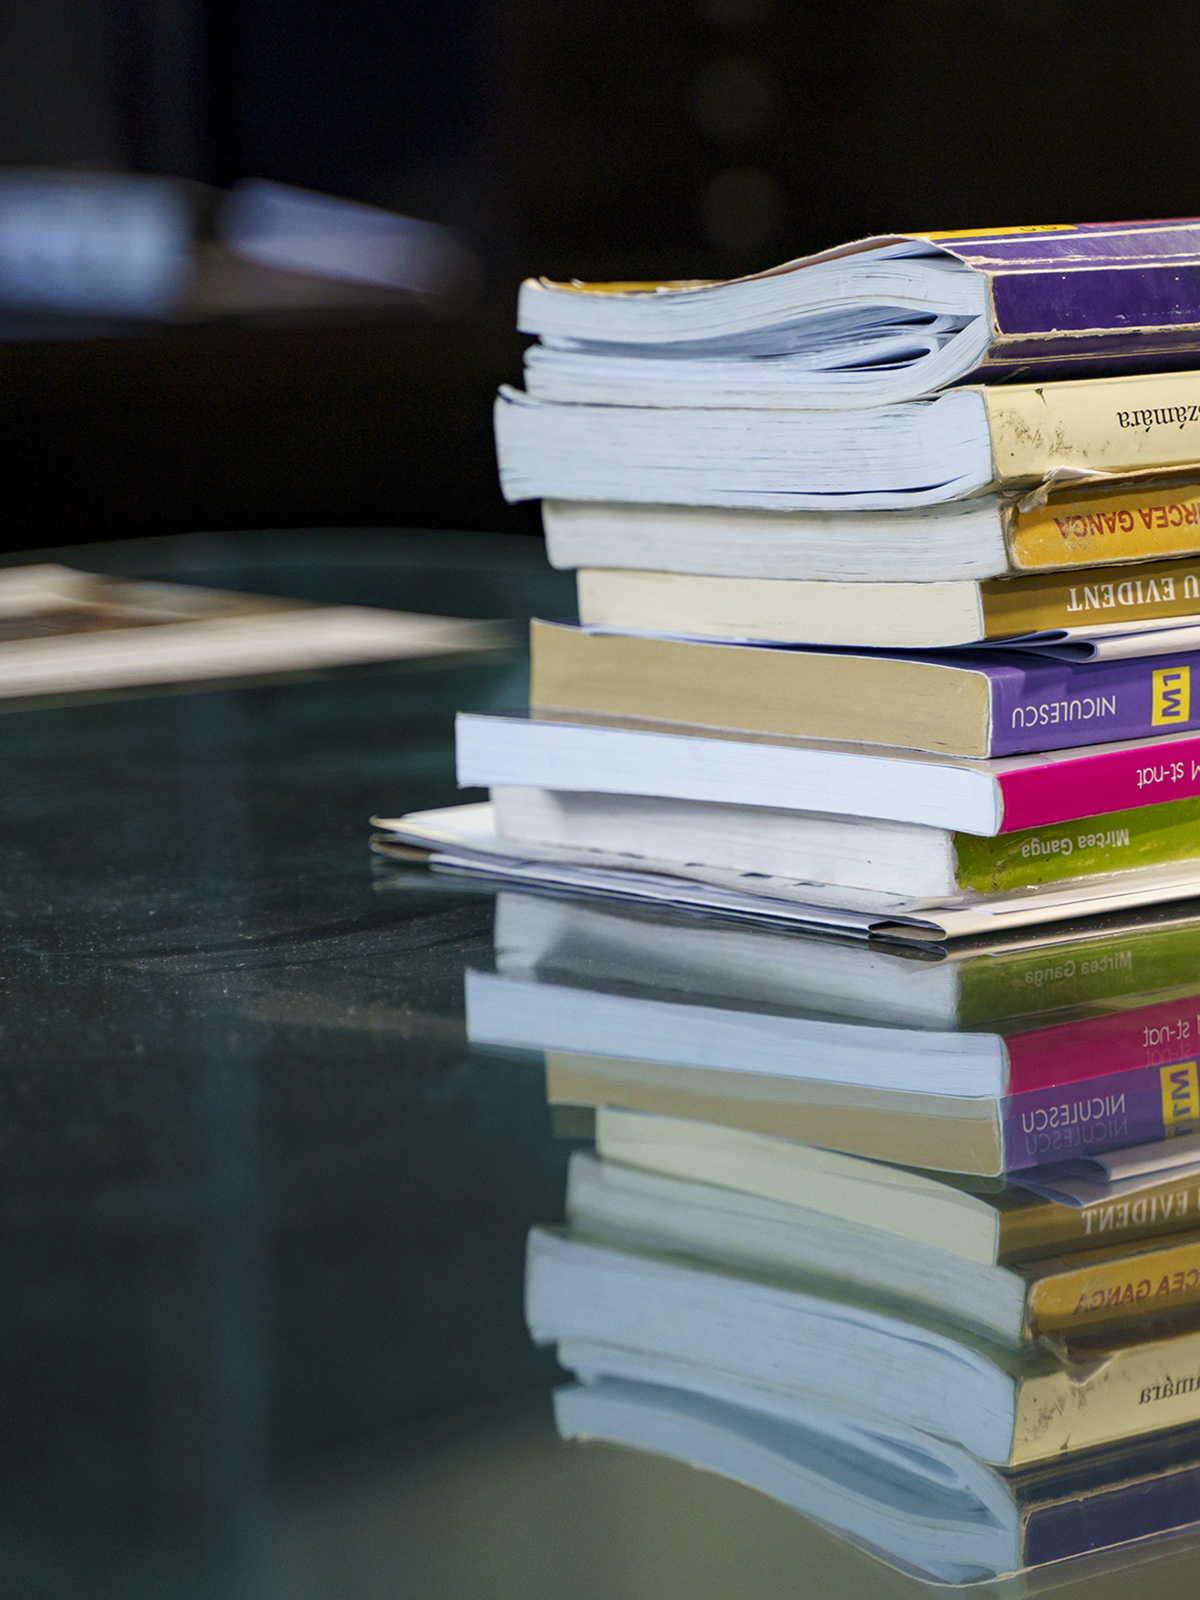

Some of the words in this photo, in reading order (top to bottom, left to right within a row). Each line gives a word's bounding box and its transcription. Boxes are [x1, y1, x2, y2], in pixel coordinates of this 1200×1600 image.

[1052, 510, 1135, 540] GANGA
[1066, 577, 1175, 612] EVIDENT
[1161, 673, 1182, 718] M1
[1011, 695, 1116, 729] NICULESCU
[1136, 762, 1184, 789] st-nat
[1020, 837, 1073, 859] Ganga
[1077, 828, 1130, 848] Mircea
